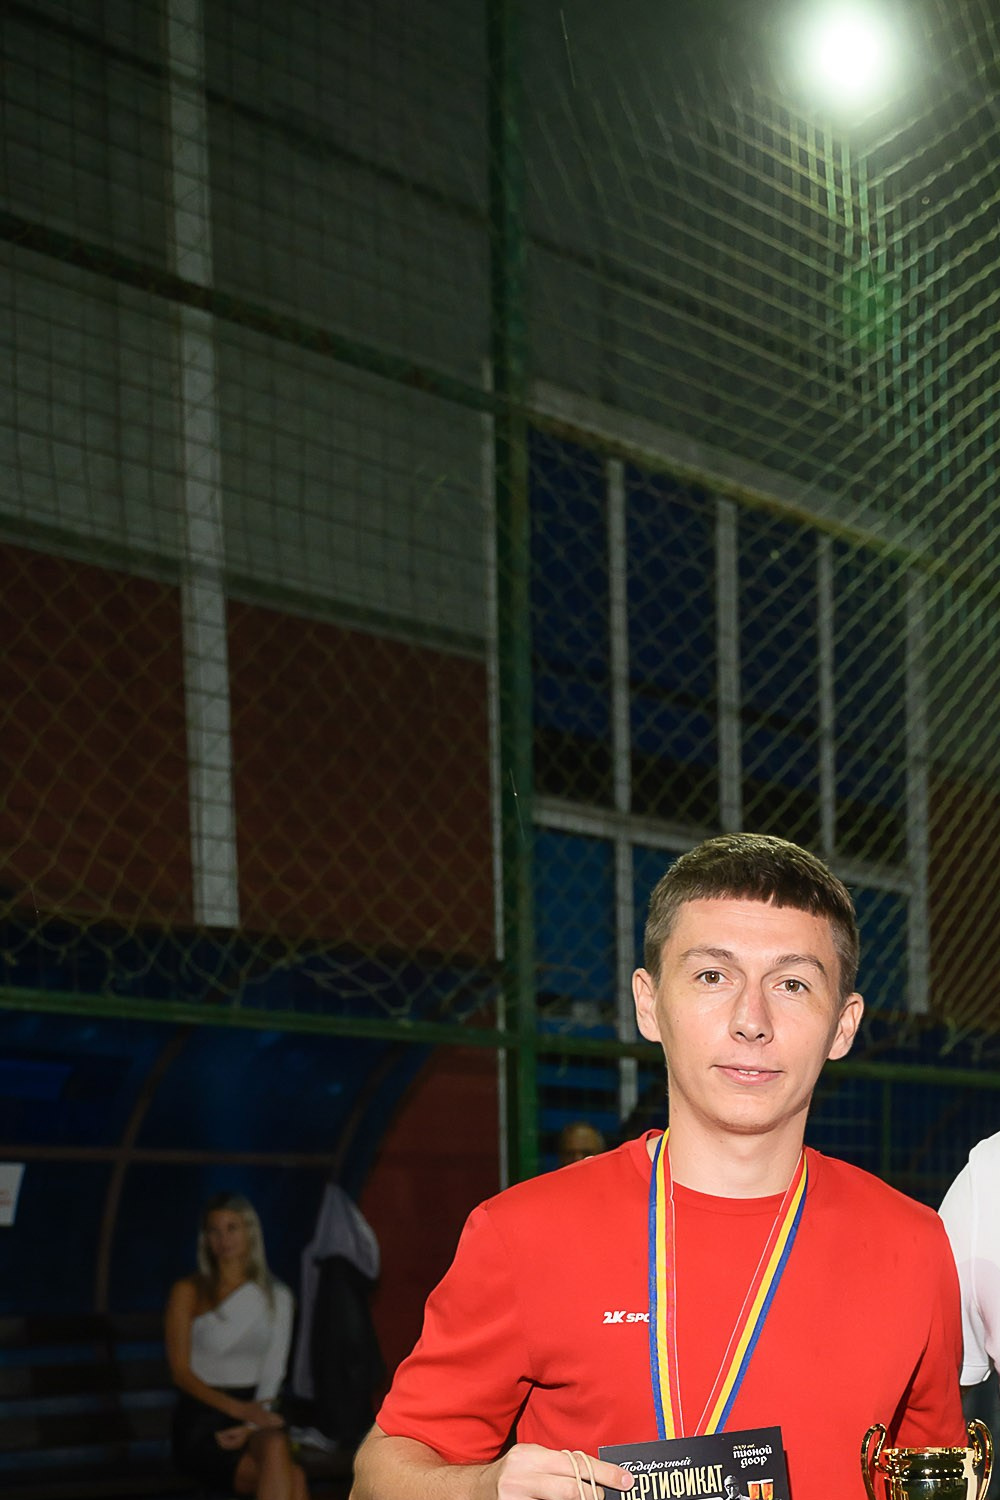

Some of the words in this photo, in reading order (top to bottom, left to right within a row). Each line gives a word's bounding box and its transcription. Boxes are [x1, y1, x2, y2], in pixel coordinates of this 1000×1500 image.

[603, 1310, 627, 1323] 2K
[626, 1313, 649, 1322] SPO
[619, 1457, 691, 1473] Подарочный
